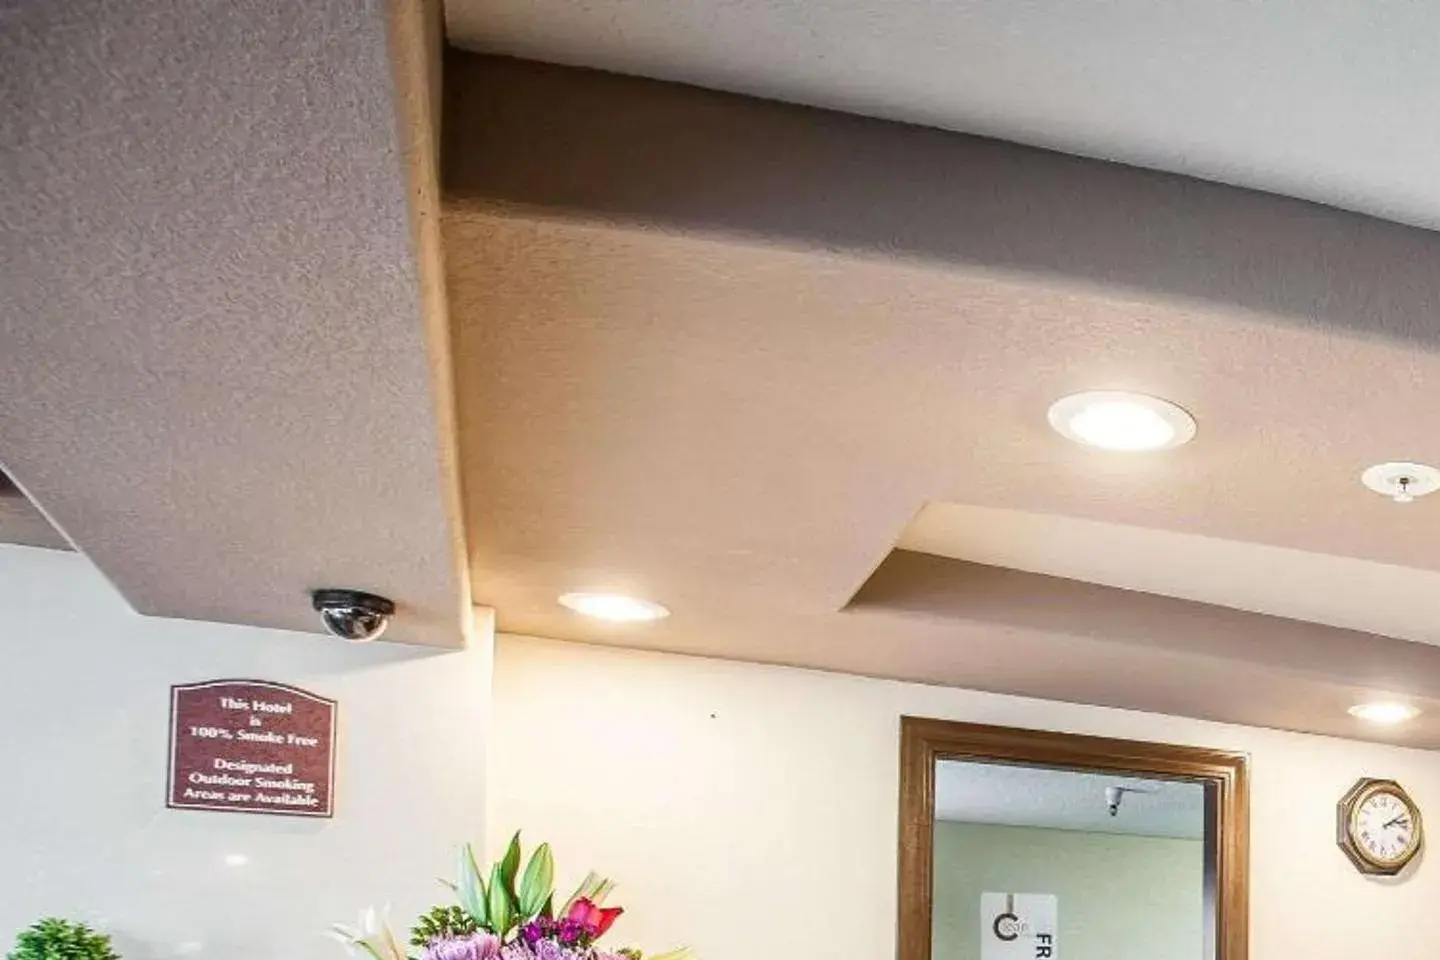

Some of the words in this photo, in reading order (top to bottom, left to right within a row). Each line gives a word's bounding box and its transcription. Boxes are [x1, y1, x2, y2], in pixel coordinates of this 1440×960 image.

[219, 697, 249, 710] This
[253, 700, 292, 713] Hotel
[250, 715, 262, 726] is
[190, 727, 233, 740] 100%
[236, 729, 285, 744] Smoke
[288, 734, 318, 747] Free
[213, 758, 292, 775] Designated
[188, 771, 251, 786] Outdoor
[255, 777, 315, 793] Smoking
[183, 788, 225, 800] Areas
[228, 792, 251, 801] are
[255, 793, 319, 807] Available
